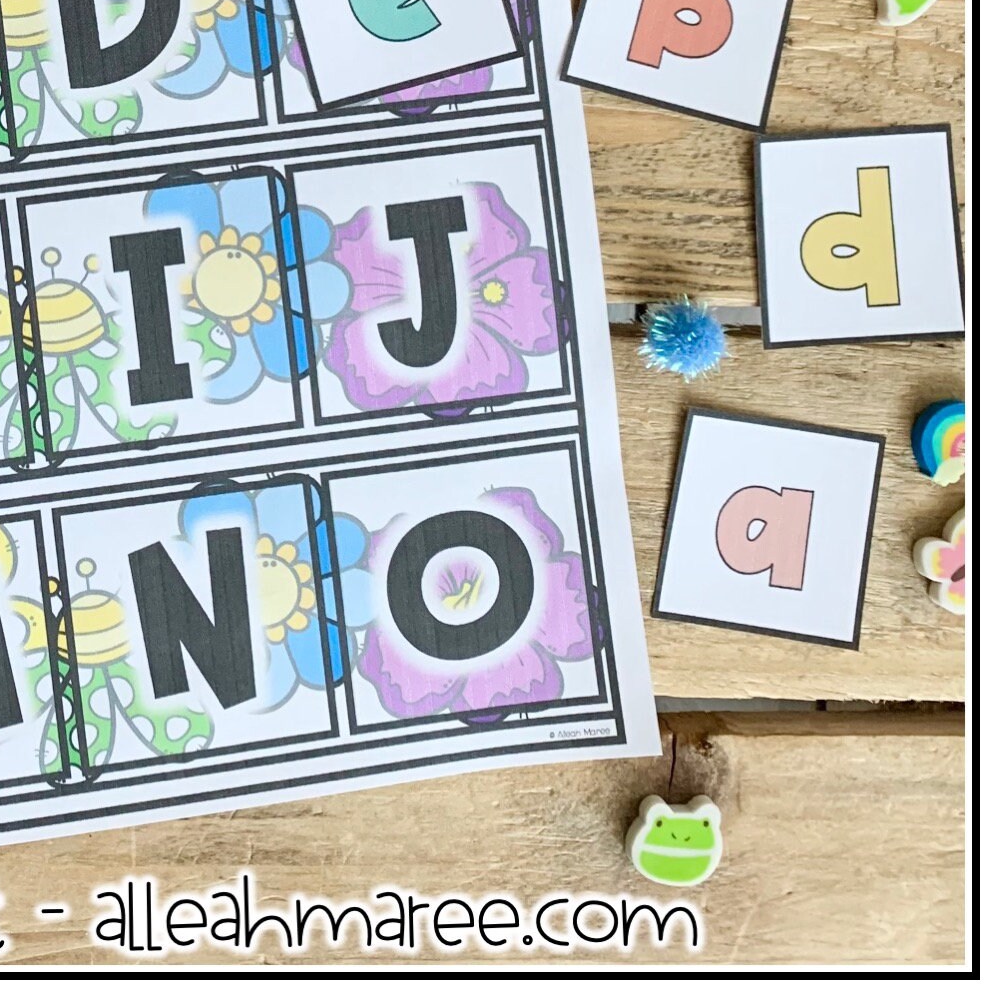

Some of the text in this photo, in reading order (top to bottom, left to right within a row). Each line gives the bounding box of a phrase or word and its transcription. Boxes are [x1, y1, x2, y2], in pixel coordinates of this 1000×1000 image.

[378, 196, 467, 367] J
[800, 166, 900, 307] d
[110, 228, 192, 405] I
[128, 528, 255, 708] N
[388, 511, 533, 659] O
[715, 485, 815, 593] a
